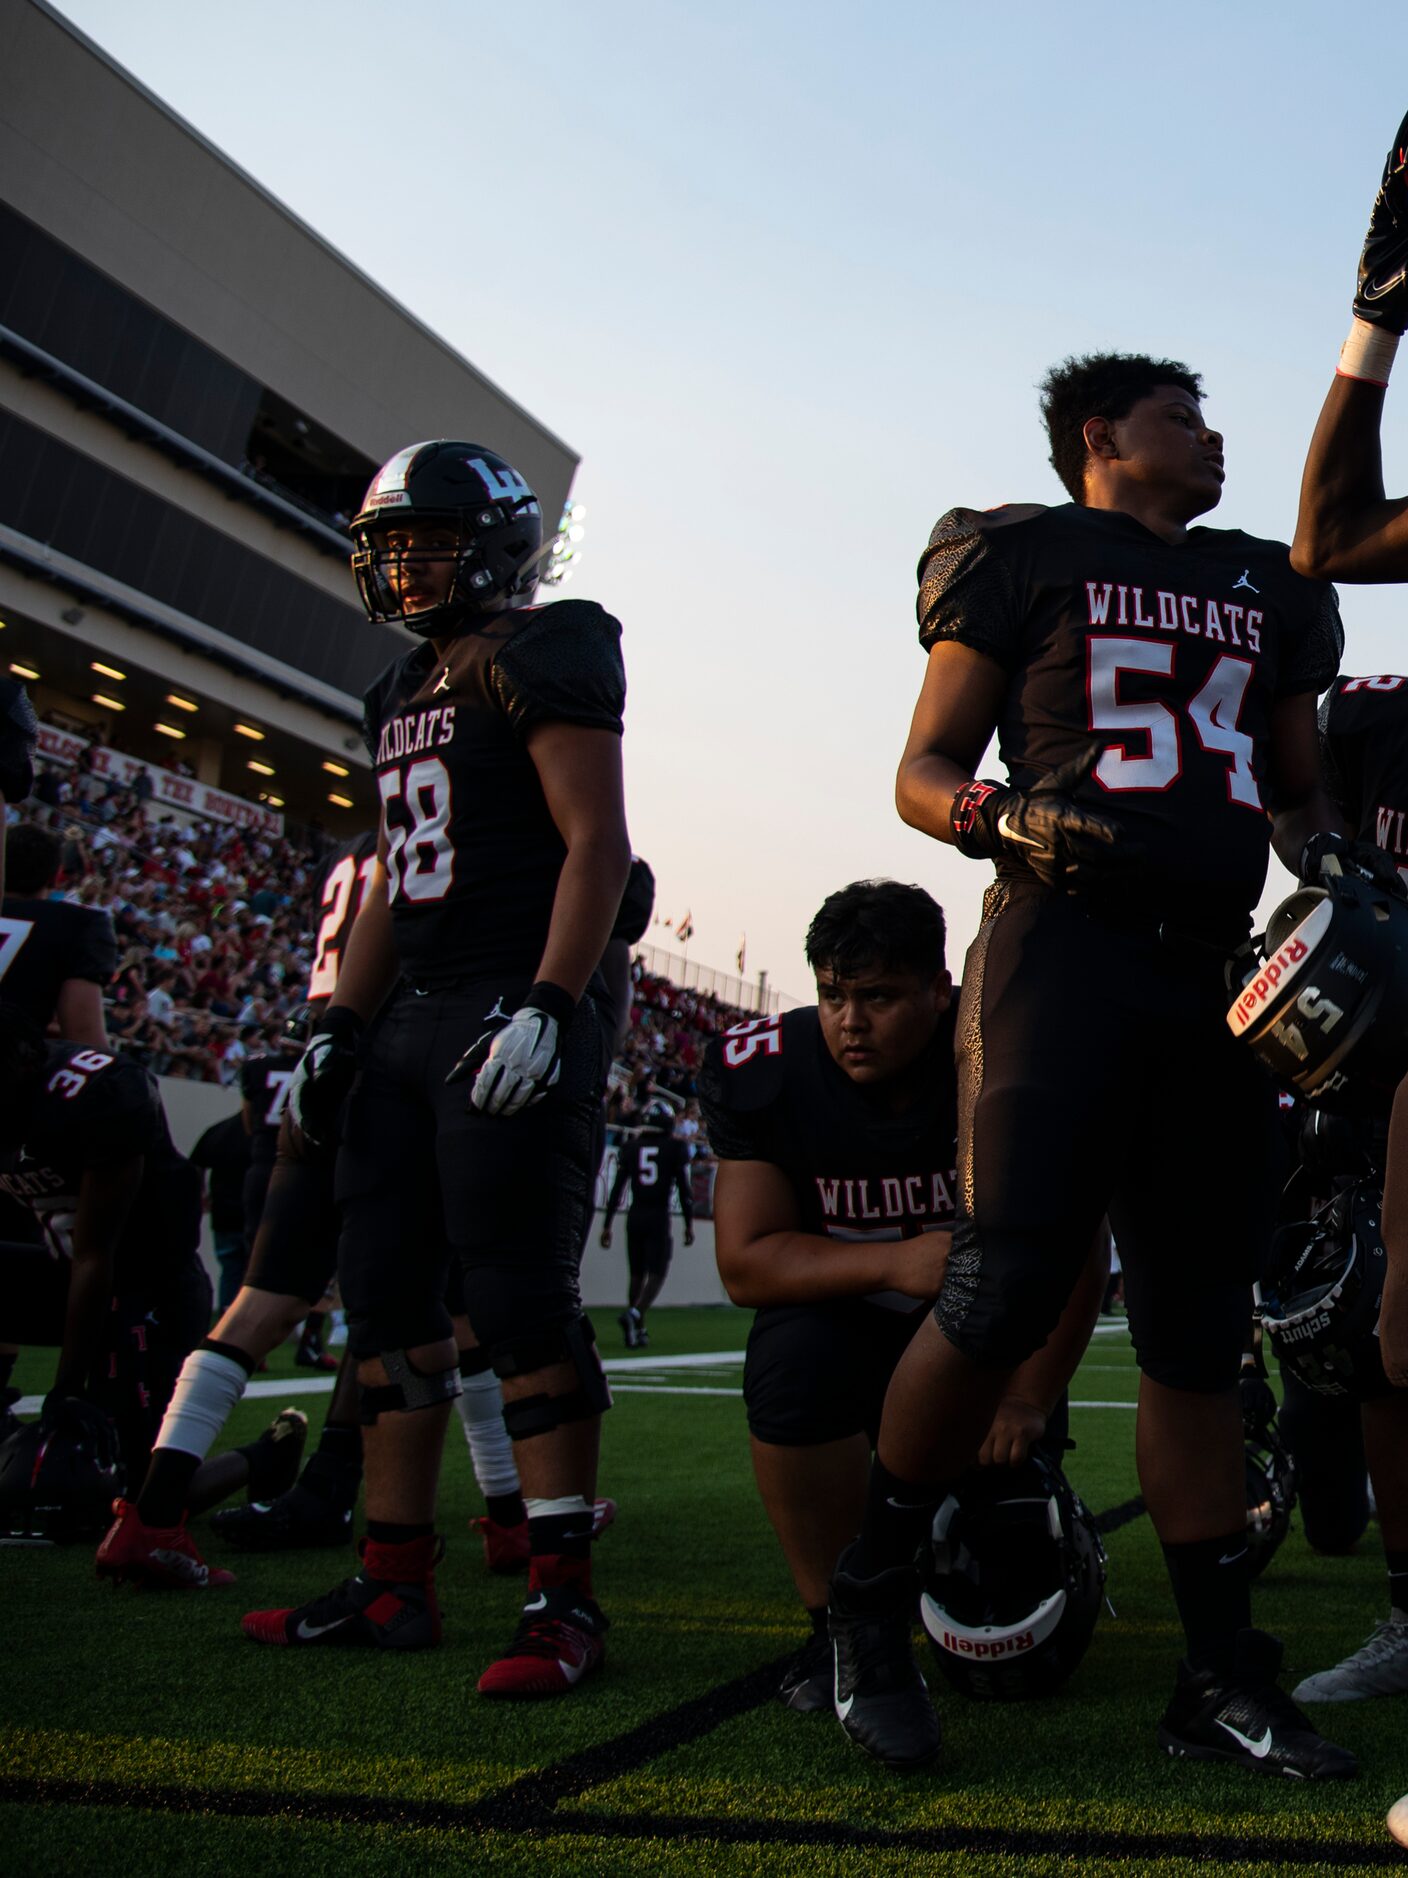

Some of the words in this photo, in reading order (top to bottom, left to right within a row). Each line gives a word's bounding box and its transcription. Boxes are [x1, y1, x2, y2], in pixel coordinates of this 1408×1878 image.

[1083, 580, 1265, 655] WILDCATS
[1085, 633, 1268, 816] 54
[377, 754, 456, 905] 58
[1236, 938, 1309, 1027] Riddell
[1270, 985, 1345, 1063] 54
[46, 1048, 116, 1102] 36
[637, 1146, 661, 1187] 5
[1279, 1310, 1332, 1346] schutt
[943, 1631, 1035, 1658] Riddell
